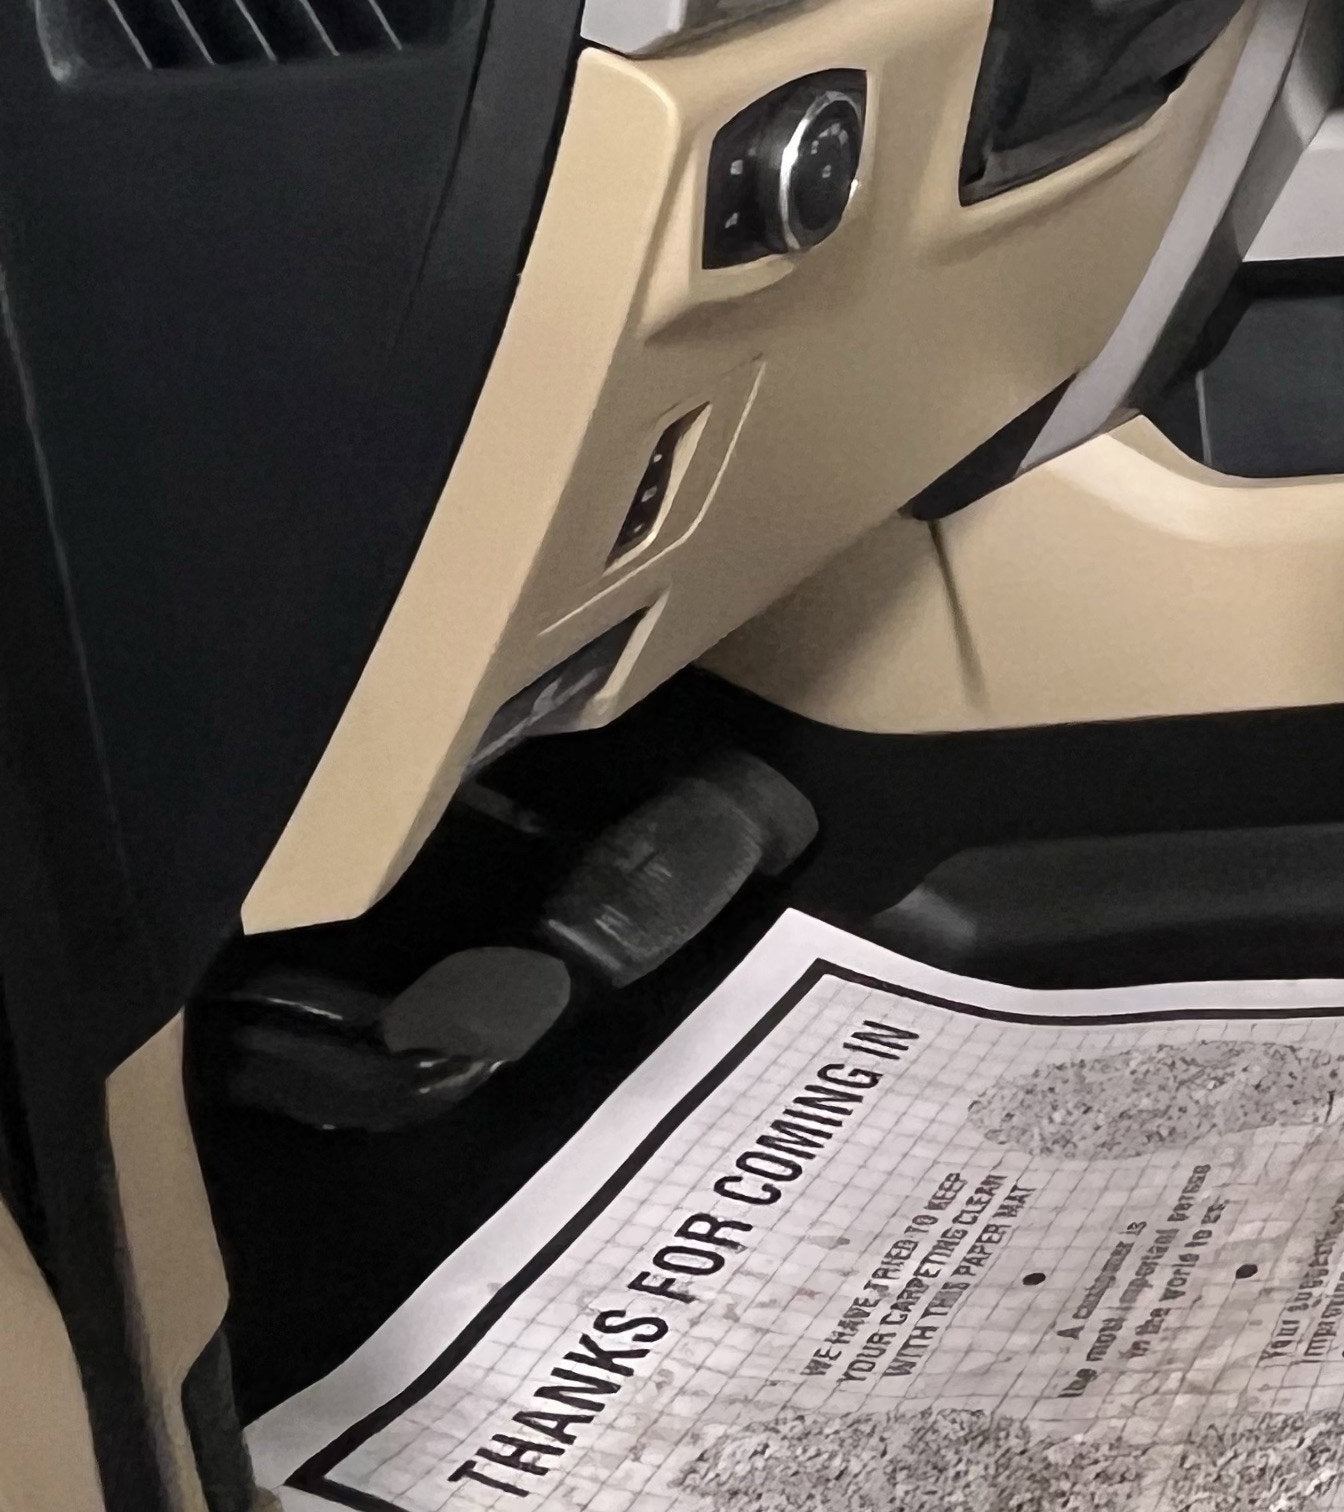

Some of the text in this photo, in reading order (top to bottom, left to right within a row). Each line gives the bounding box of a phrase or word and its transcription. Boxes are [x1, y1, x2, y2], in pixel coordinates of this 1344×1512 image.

[448, 1020, 920, 1497] THANKS FOR COMING IN
[800, 1172, 967, 1376] WE HAVE TRIED TO KEEP
[836, 1174, 1008, 1383] YOUR CARPETING CLEAN
[882, 1326, 939, 1377] WITH
[950, 1224, 1012, 1277] PAPER
[993, 1184, 1037, 1217] MAT
[1057, 1325, 1085, 1340] A
